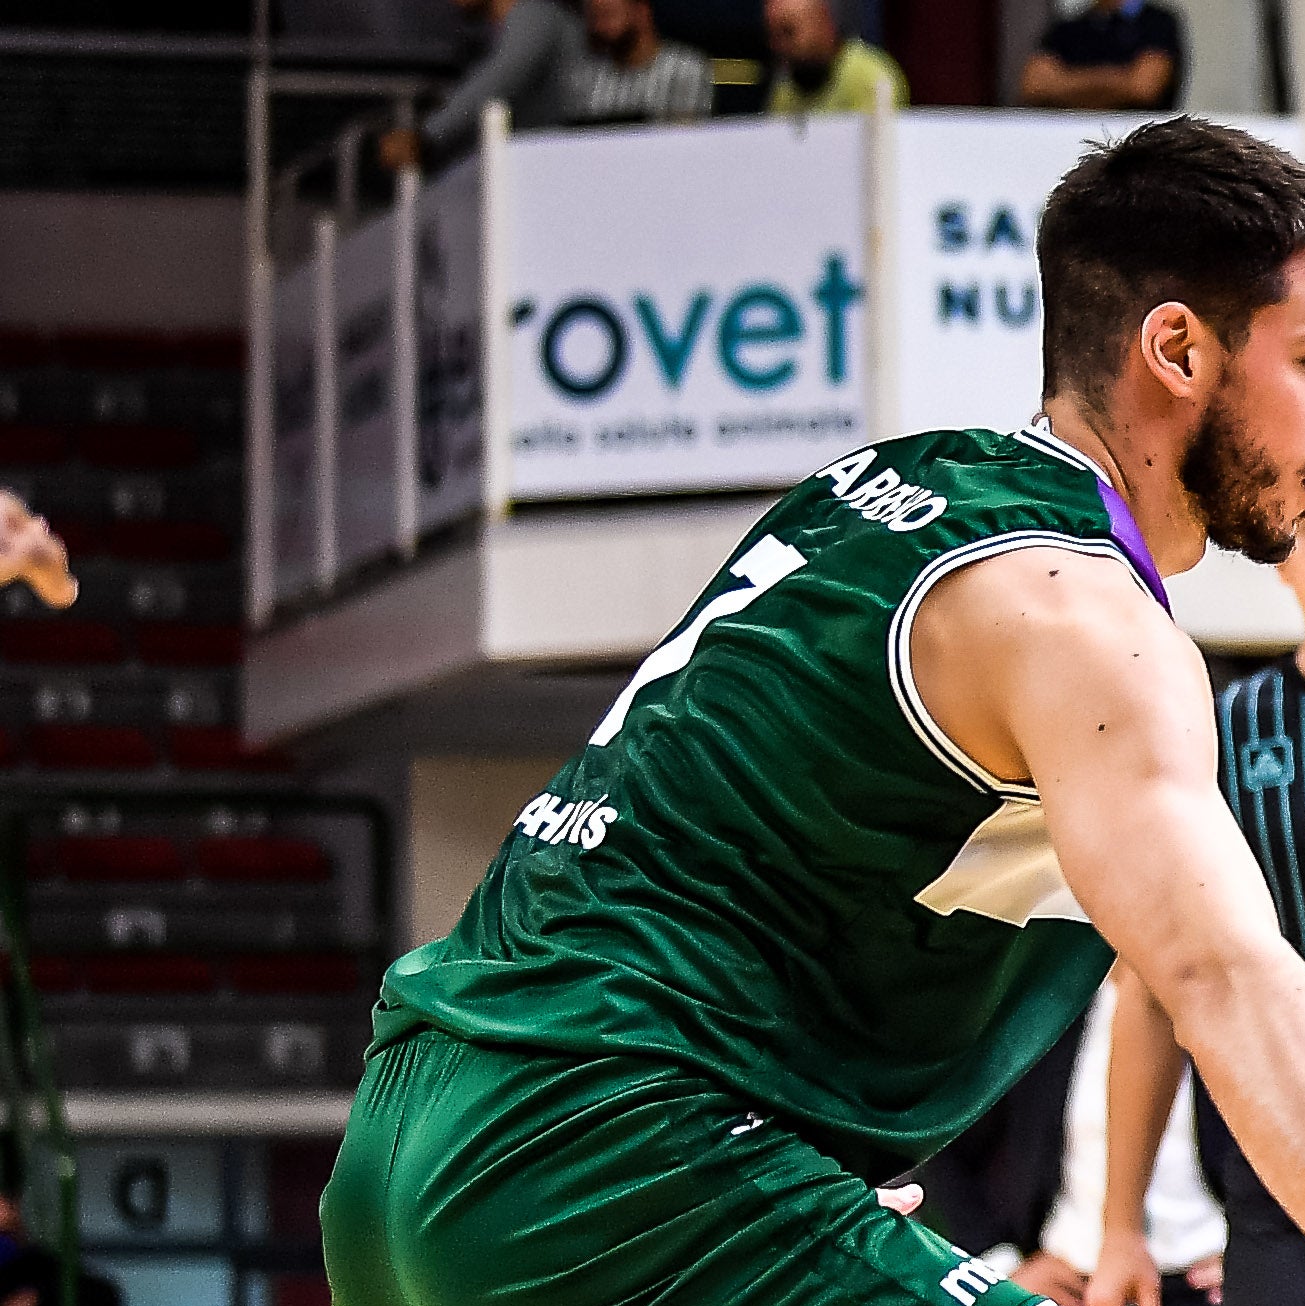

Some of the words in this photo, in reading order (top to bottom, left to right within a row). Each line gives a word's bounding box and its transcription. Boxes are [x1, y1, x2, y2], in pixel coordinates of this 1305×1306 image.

[934, 203, 1042, 252] SA
[936, 276, 1036, 330] NU
[588, 533, 808, 747] 7
